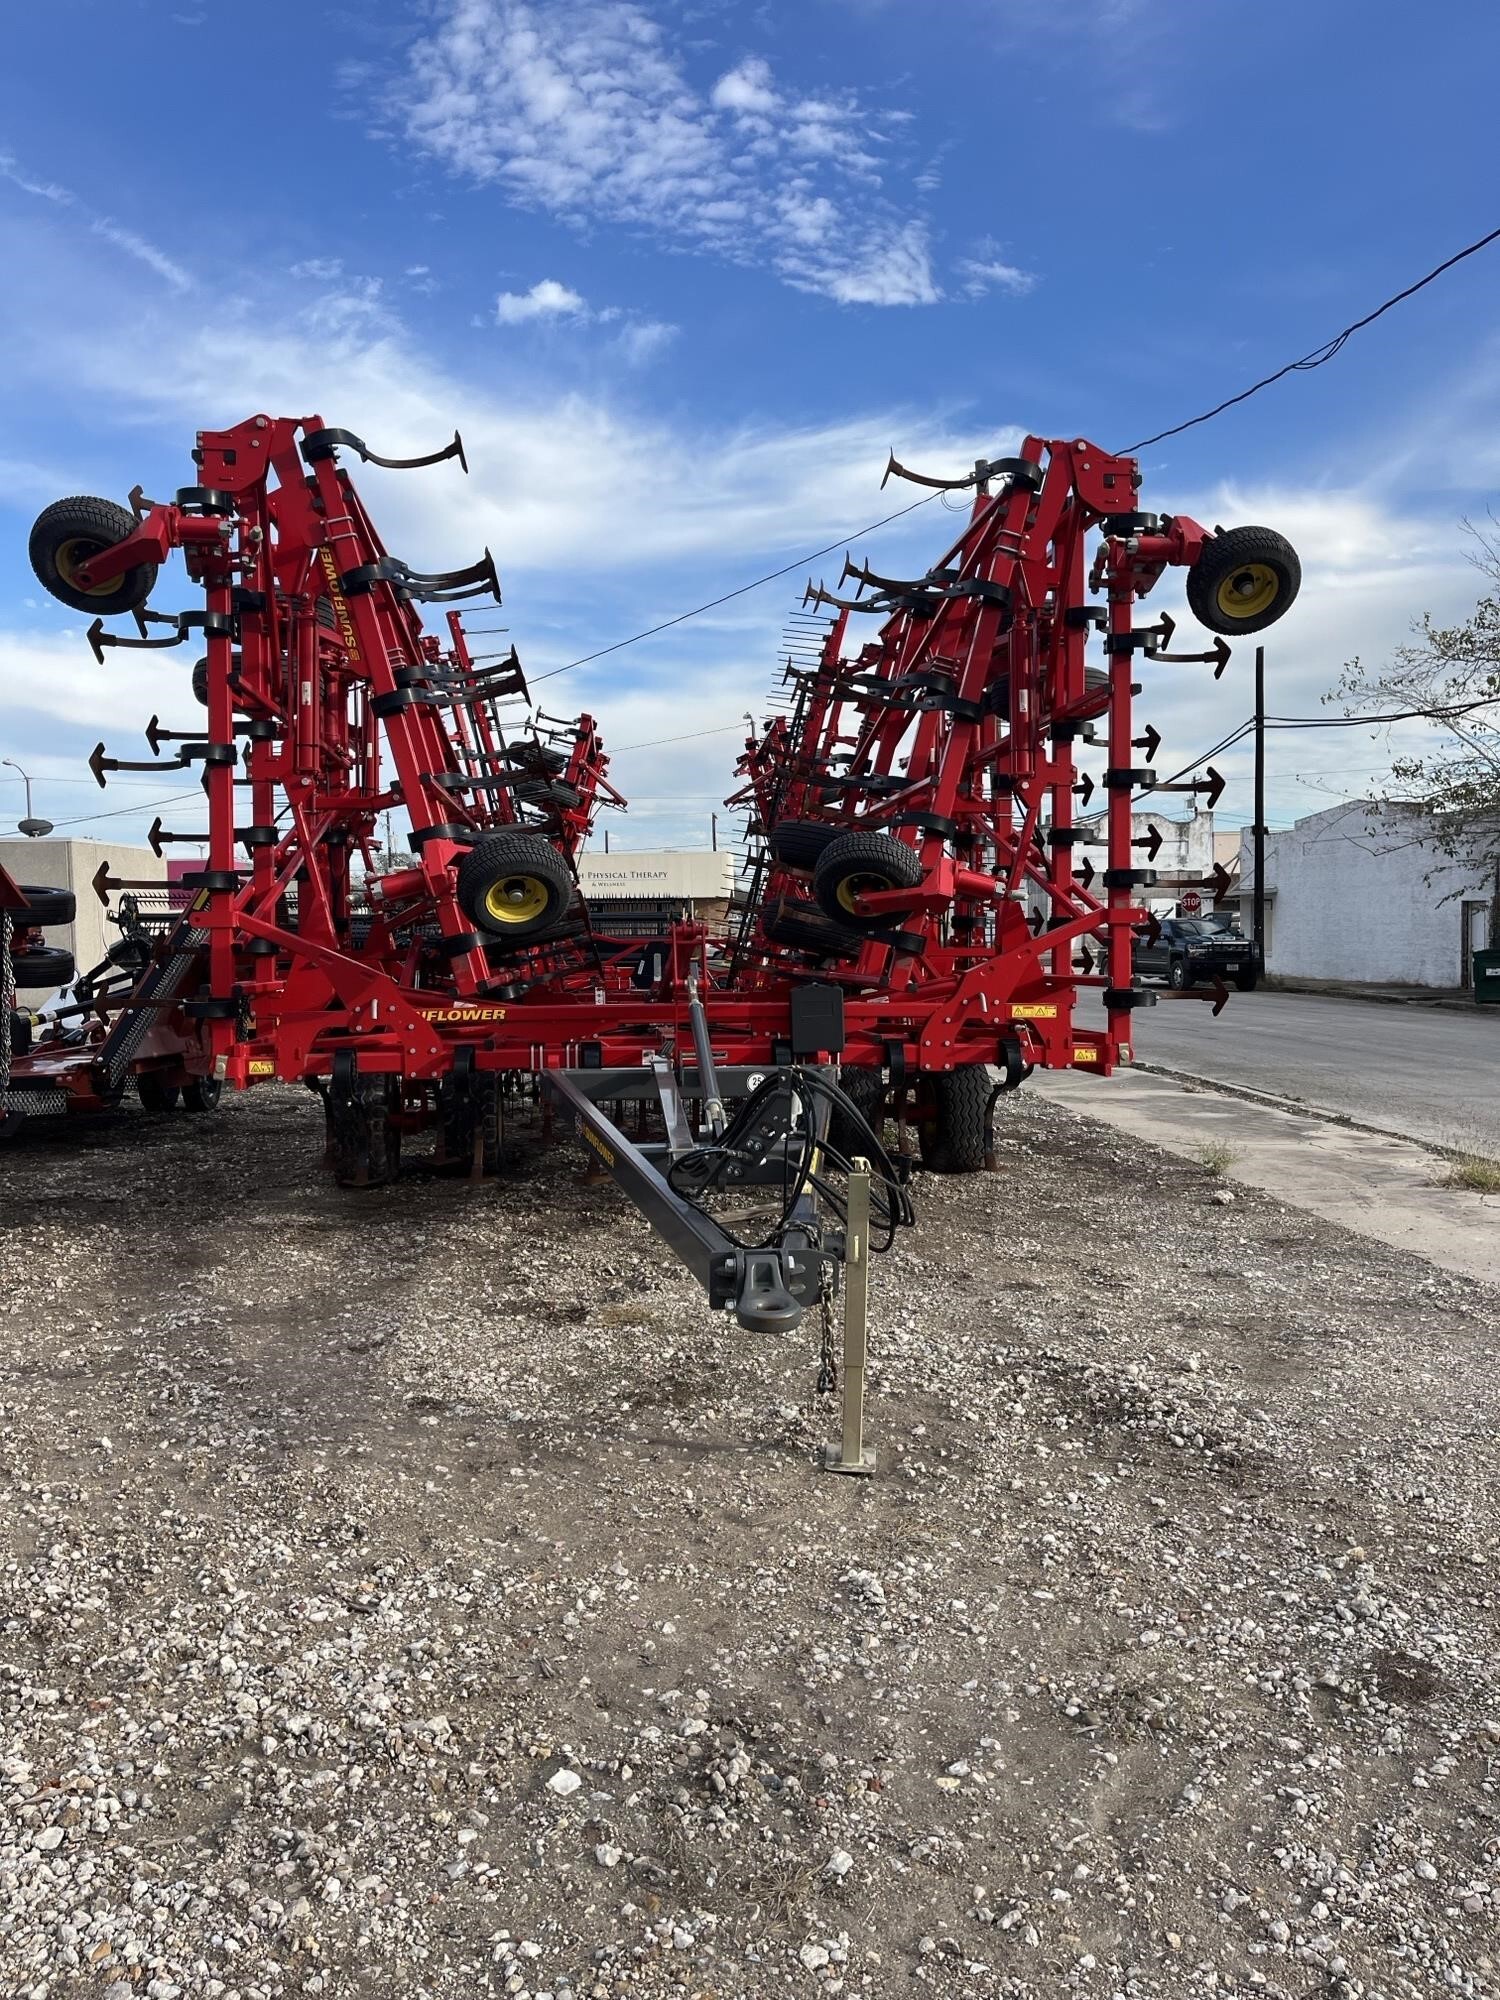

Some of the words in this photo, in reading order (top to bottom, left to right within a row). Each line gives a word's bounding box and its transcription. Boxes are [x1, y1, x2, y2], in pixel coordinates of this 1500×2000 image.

[588, 871, 628, 879] PHYSICAL
[1183, 897, 1201, 907] STOP
[416, 1008, 506, 1022] FLOWER
